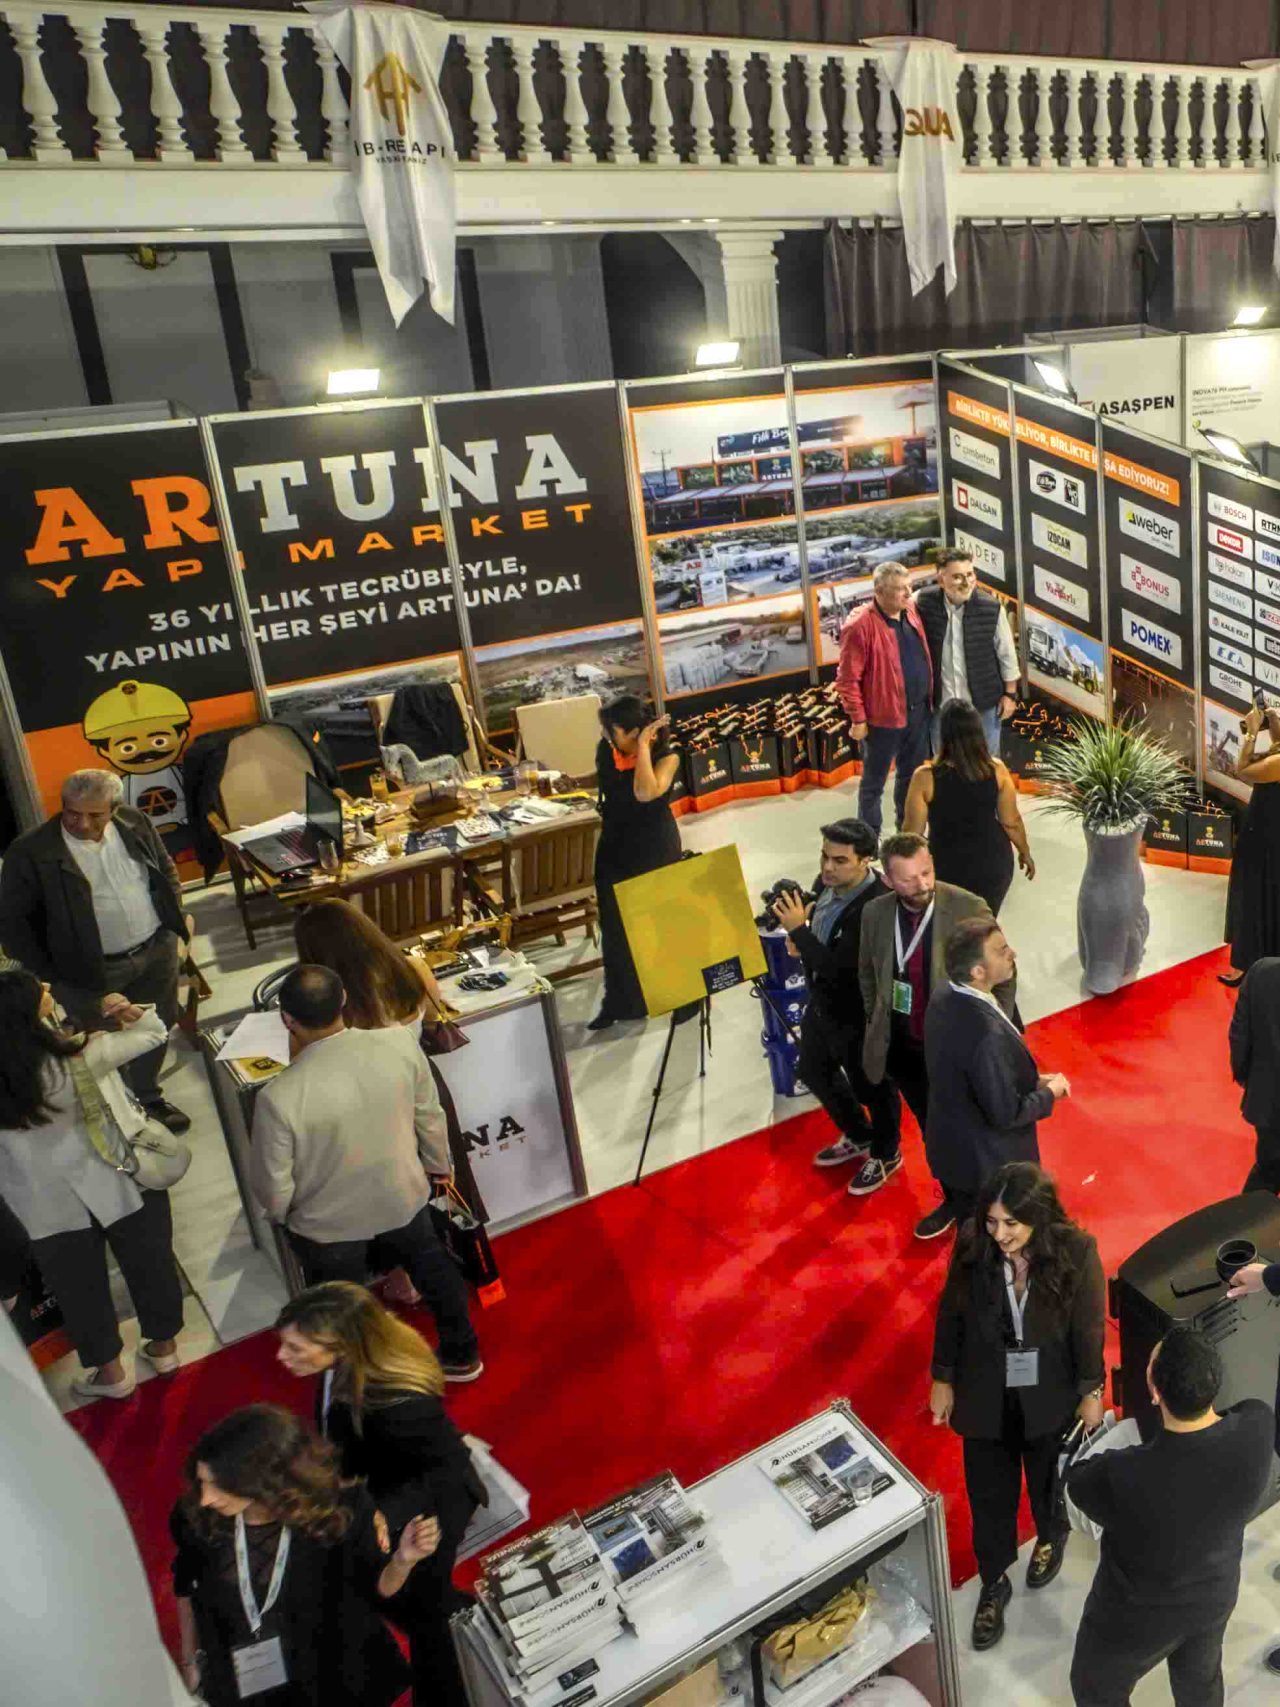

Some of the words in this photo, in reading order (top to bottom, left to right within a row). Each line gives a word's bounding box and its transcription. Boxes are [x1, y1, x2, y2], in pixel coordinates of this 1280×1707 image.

[1099, 395, 1175, 416] ASAŞPEN
[991, 414, 1049, 447] YÜKELİYOR,
[1050, 436, 1091, 463] BİRLİKTE
[1091, 450, 1118, 475] İŞA
[1118, 462, 1170, 497] EDİYORUZ!
[25, 433, 588, 566] ARTUNA
[970, 496, 998, 517] DALSAN
[1224, 505, 1247, 520] BOSCH
[1135, 512, 1174, 541] weber
[35, 550, 247, 599] YAPI
[288, 503, 593, 564] MARKET
[149, 609, 190, 632] 36
[320, 556, 527, 603] TECRÜBEYLE,
[1141, 575, 1169, 597] BONUS
[1214, 588, 1246, 610] SIEMENS
[85, 633, 231, 673] YAPININ
[242, 618, 312, 648] HER
[319, 602, 388, 635] ŞEYİ
[535, 573, 582, 597] DA!
[1131, 621, 1172, 655] POMEX
[1219, 672, 1243, 689] GROHE
